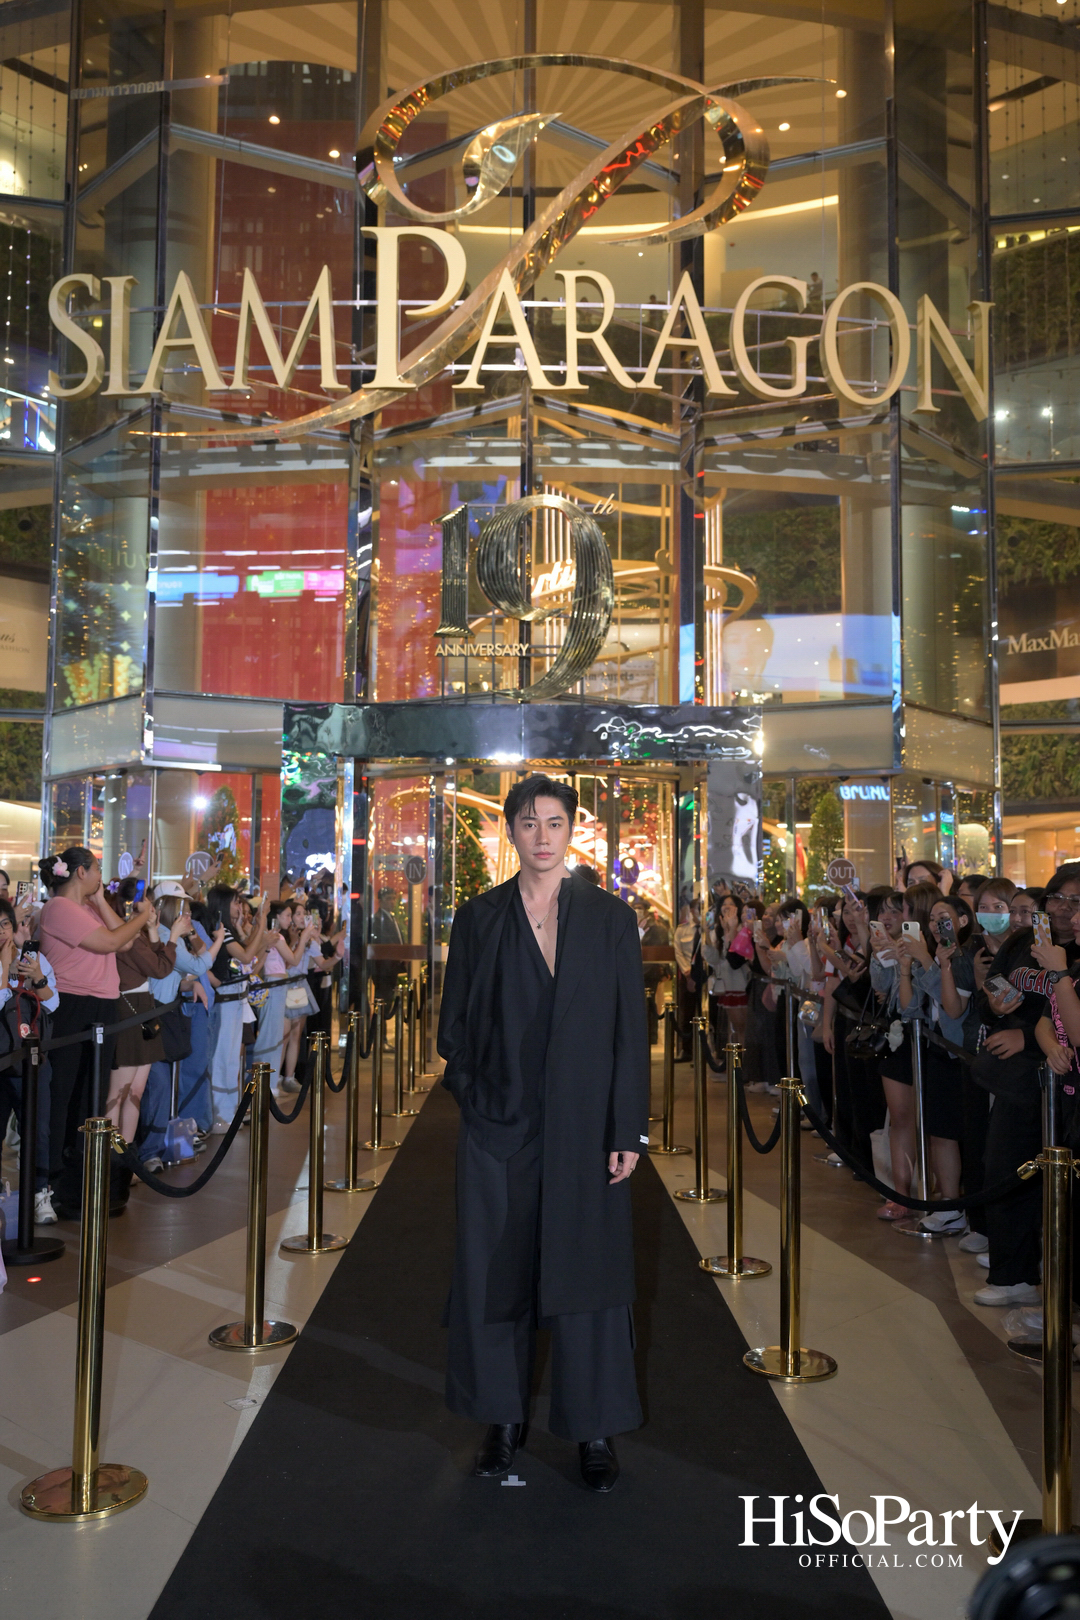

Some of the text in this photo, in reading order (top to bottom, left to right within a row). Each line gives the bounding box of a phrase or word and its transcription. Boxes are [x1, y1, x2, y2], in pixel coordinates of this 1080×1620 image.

[48, 226, 996, 423] SIAM PARAGON
[1006, 626, 1080, 656] MaxMa
[434, 643, 529, 657] ANNIVERSARY
[191, 859, 210, 875] IN
[408, 862, 422, 879] IN
[829, 866, 855, 879] OUT
